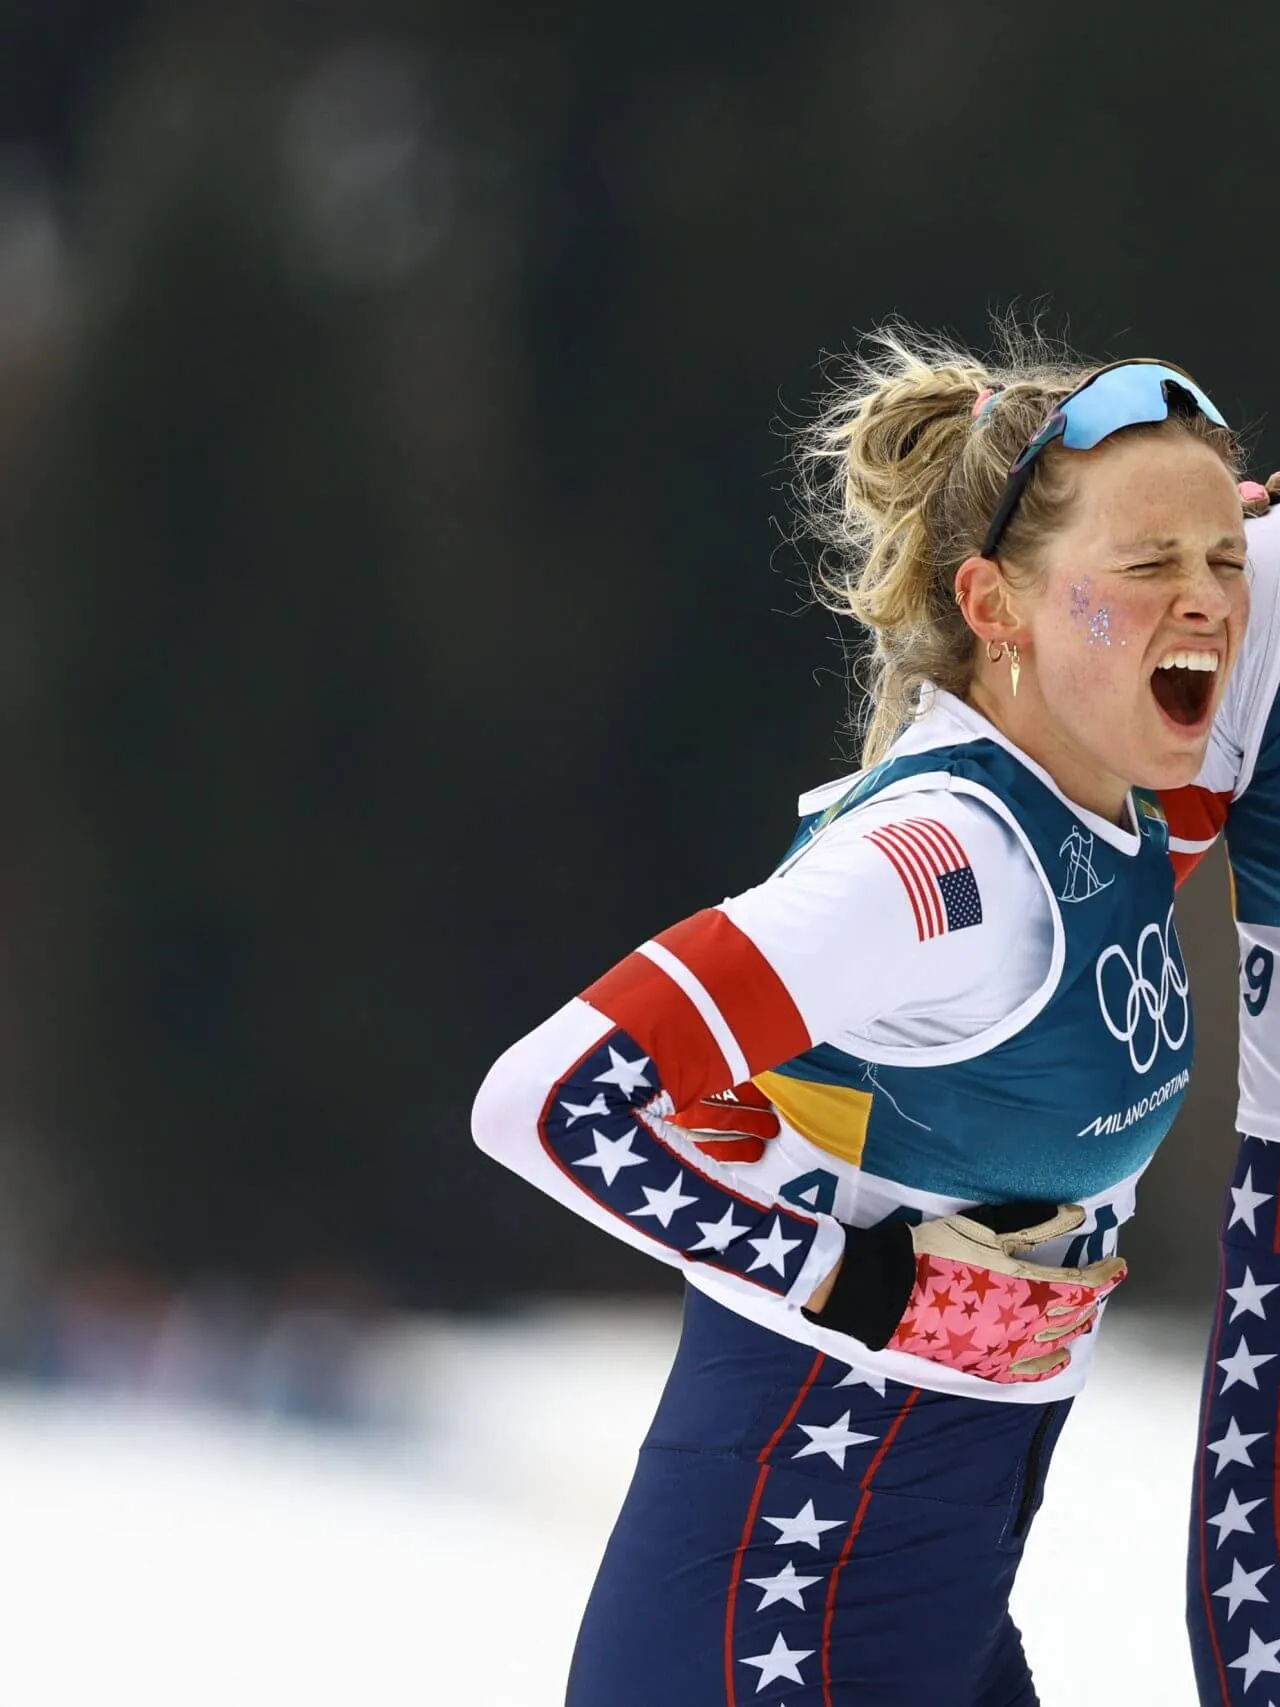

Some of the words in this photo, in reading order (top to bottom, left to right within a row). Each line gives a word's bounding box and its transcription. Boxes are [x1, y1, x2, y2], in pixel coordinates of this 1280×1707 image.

[1239, 943, 1274, 1017] 9
[1077, 1097, 1149, 1137] MILANO
[1148, 1067, 1190, 1112] CORTINA
